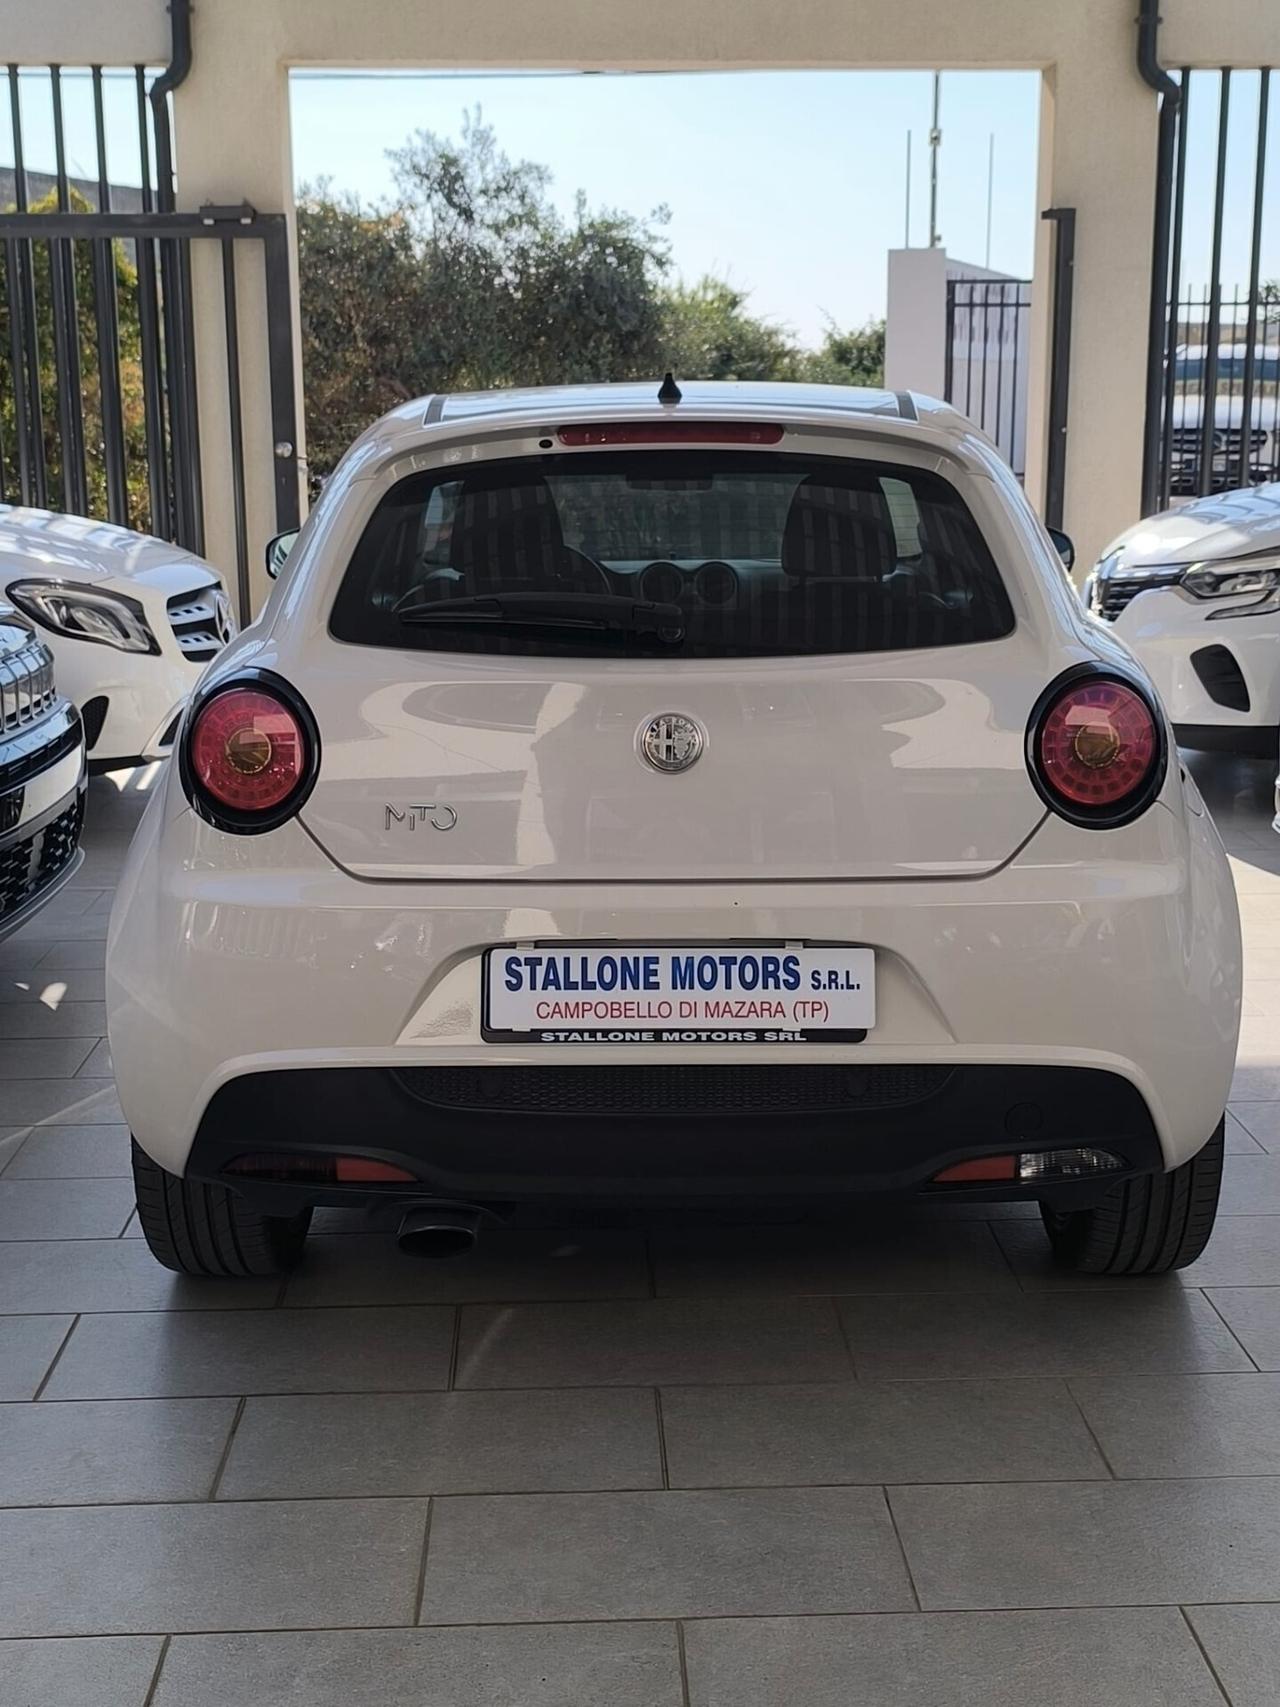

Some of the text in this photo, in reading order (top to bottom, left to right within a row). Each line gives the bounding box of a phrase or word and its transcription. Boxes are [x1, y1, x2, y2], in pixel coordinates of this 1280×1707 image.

[504, 955, 861, 991] STALLONE MOTORS S.R.L.
[536, 1001, 829, 1023] CAMPOBELLO DI MAZARA (TP)
[540, 1031, 808, 1042] STALLONE MOTORS SRL
